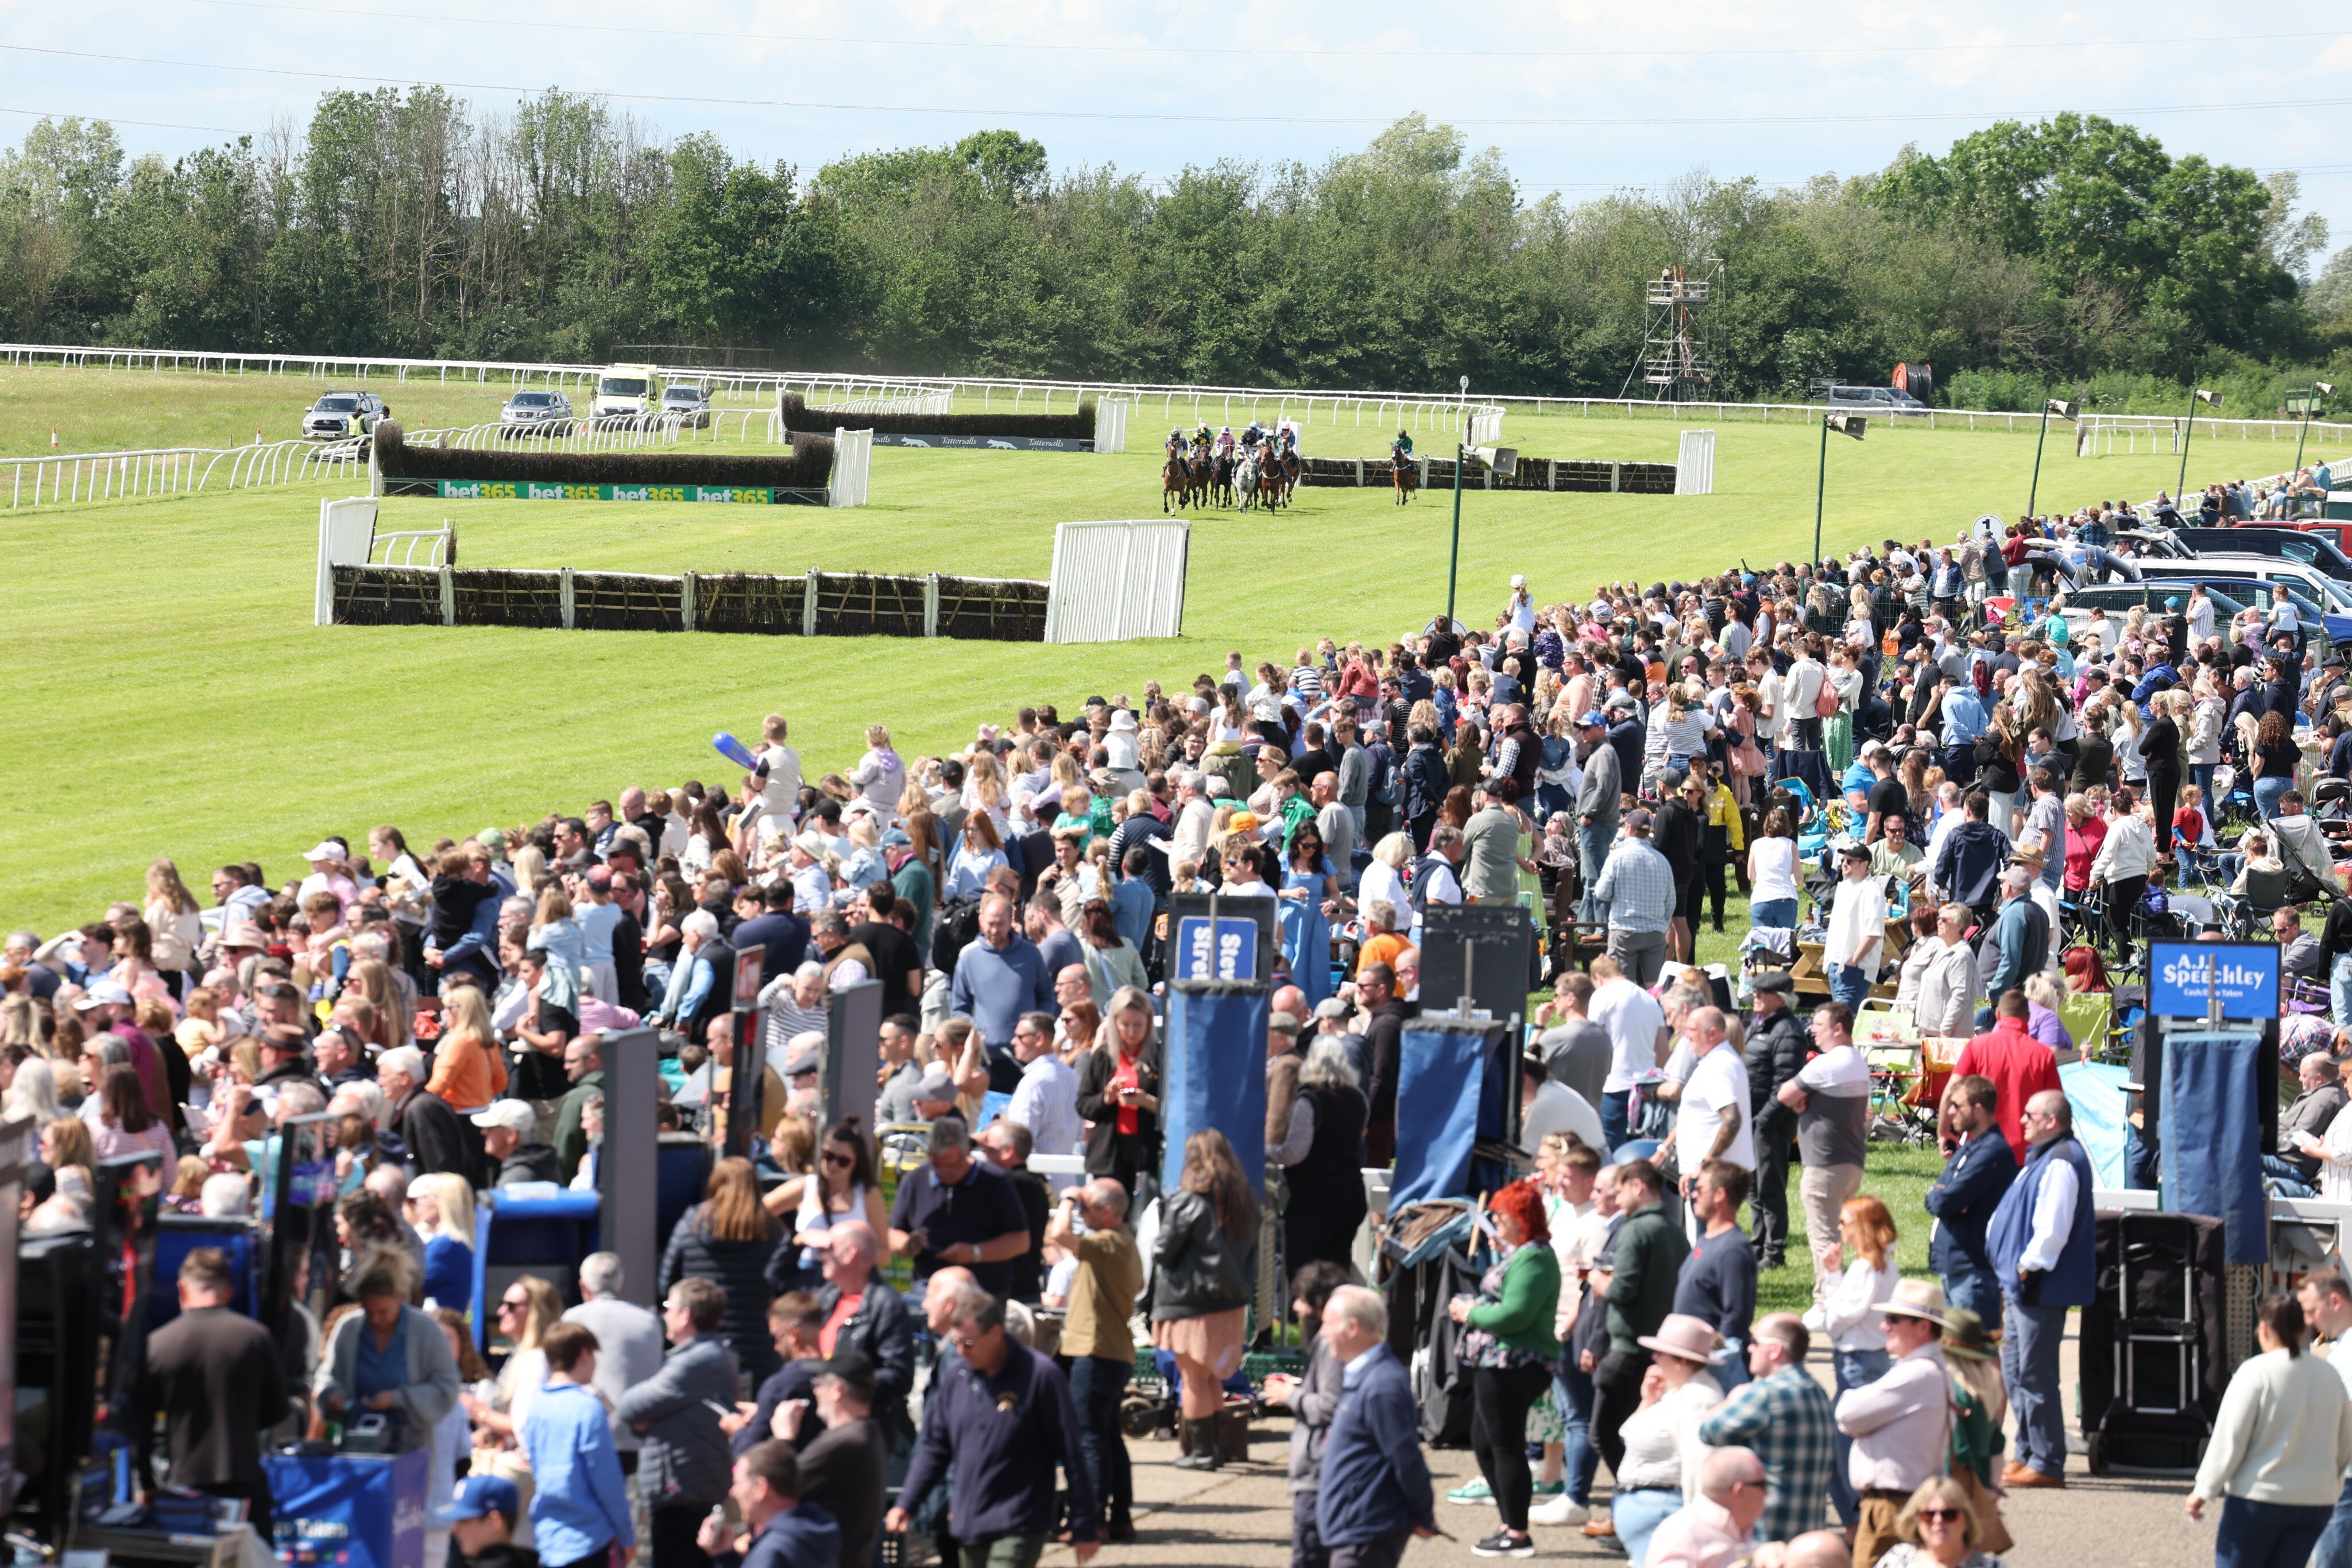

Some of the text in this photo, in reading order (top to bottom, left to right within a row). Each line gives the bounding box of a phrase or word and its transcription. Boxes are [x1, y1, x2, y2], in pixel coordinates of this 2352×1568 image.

[1028, 439, 1064, 447] Tattersalls
[444, 481, 516, 498] bet365
[528, 483, 600, 500] bet365
[613, 486, 684, 501] bet365
[697, 487, 768, 504] bet365
[1982, 519, 1993, 535] 1
[2177, 954, 2210, 970] A.J.
[2222, 989, 2243, 997] Taken
